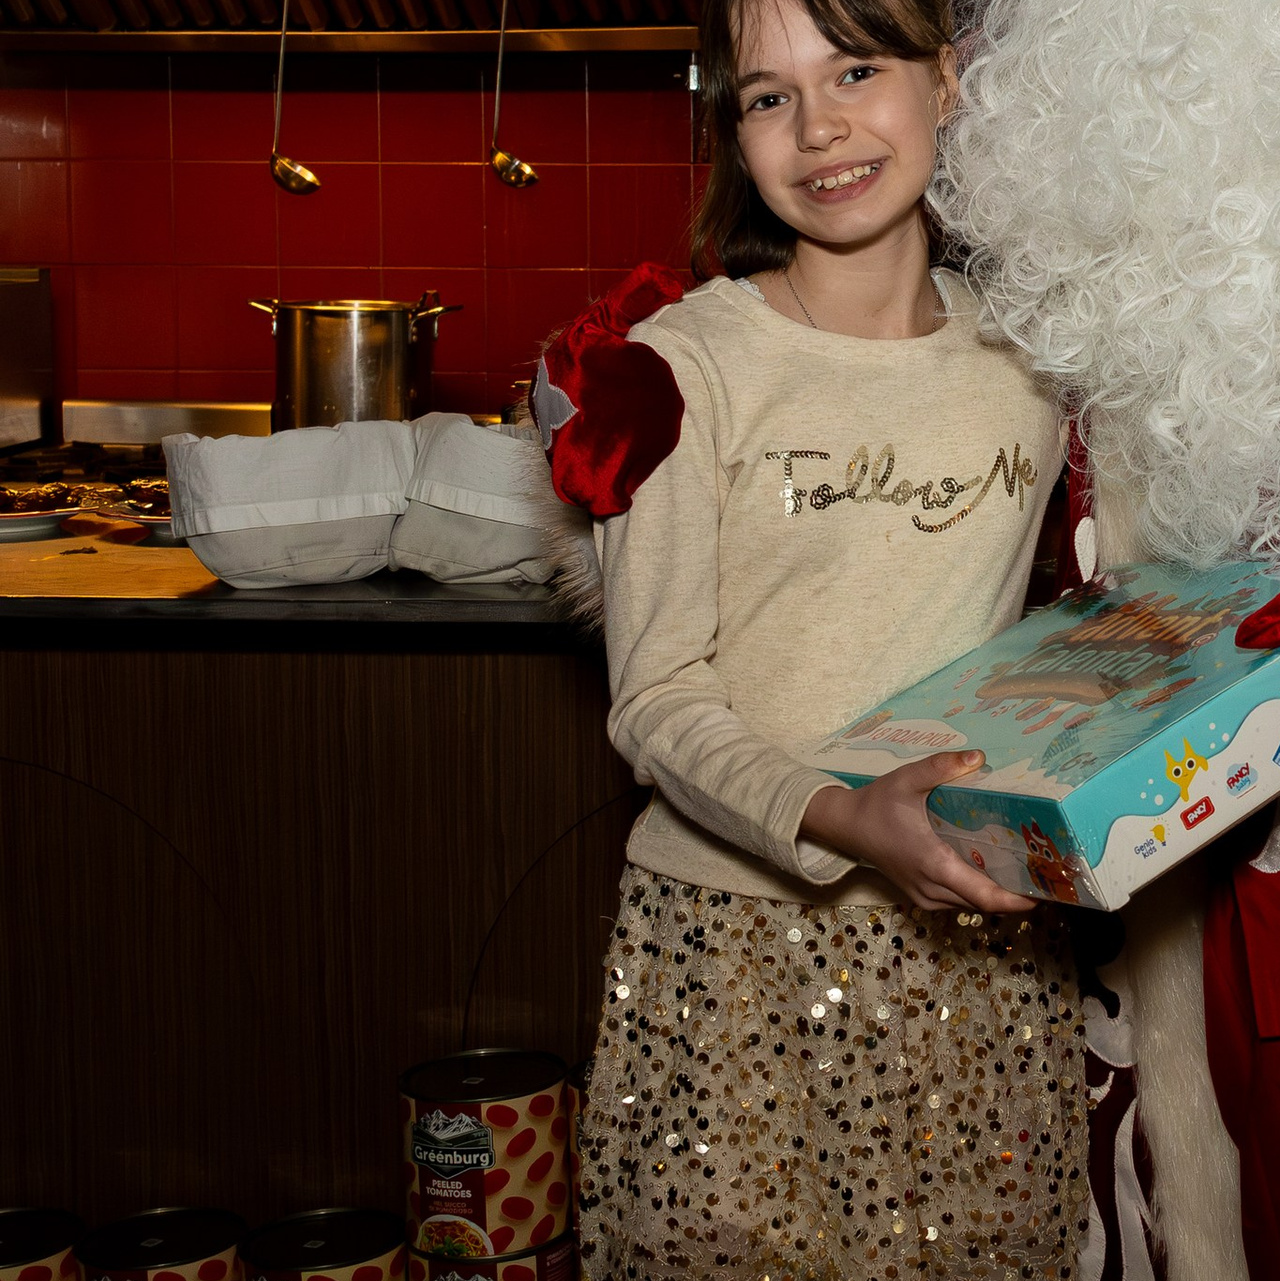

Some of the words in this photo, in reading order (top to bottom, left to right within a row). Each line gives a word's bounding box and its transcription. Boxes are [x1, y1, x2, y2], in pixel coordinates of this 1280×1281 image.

[1226, 762, 1251, 790] FANCY
[1187, 800, 1207, 824] FANCY
[426, 1186, 472, 1199] TOMATOES
[432, 1179, 463, 1190] PEELED
